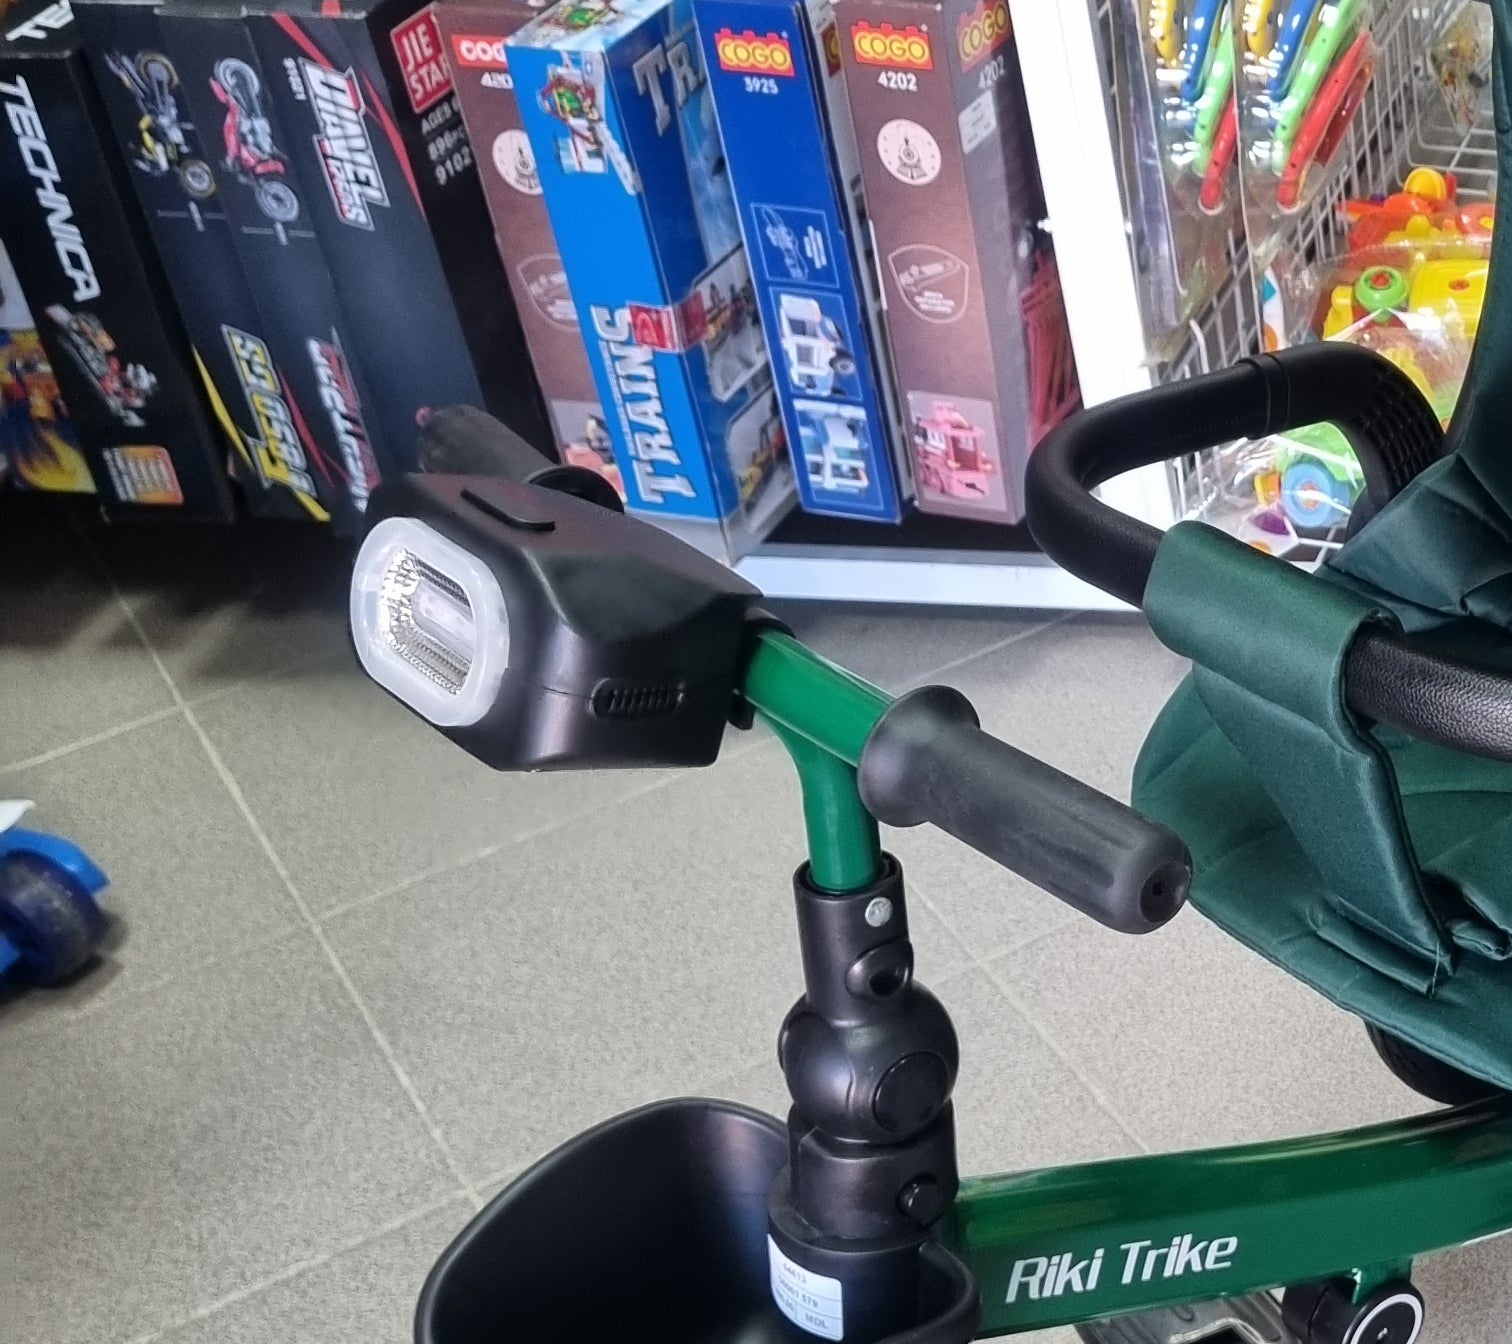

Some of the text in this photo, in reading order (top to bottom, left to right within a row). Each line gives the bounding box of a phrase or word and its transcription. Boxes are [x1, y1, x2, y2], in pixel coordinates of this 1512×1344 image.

[402, 23, 433, 73] JIE
[718, 38, 791, 71] COGO
[854, 30, 931, 64] COGO
[958, 0, 1008, 61] COGO
[877, 70, 918, 93] 4202
[590, 303, 697, 504] TRAINS
[1004, 1233, 1239, 1304] Riki Trike
